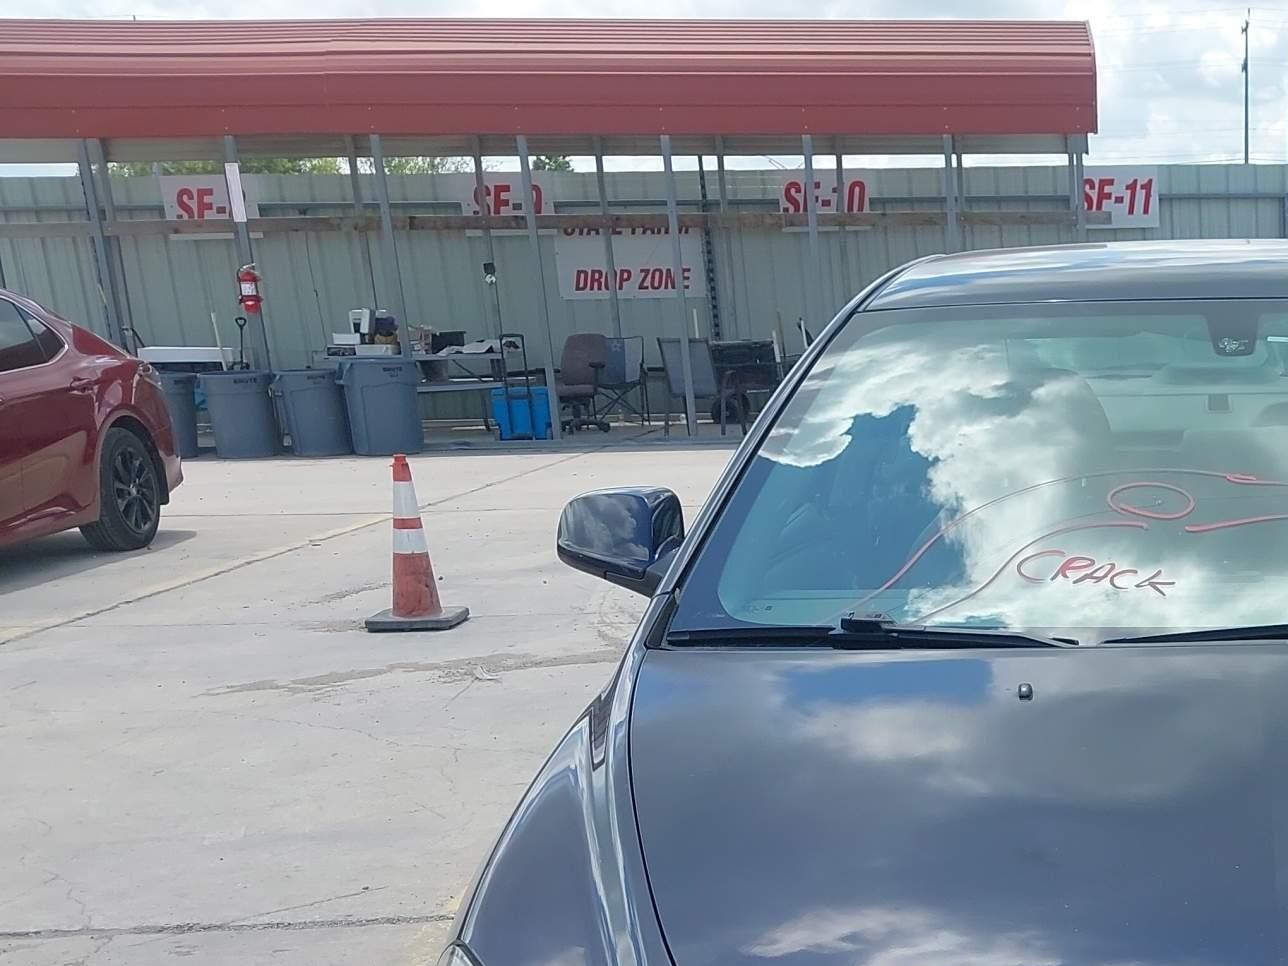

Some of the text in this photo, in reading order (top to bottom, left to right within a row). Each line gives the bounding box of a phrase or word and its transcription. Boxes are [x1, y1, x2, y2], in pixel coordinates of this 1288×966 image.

[176, 188, 246, 220] SF-
[1082, 178, 1153, 215] SF-11
[638, 268, 691, 290] ZONE
[1016, 550, 1176, 597] CRACK
